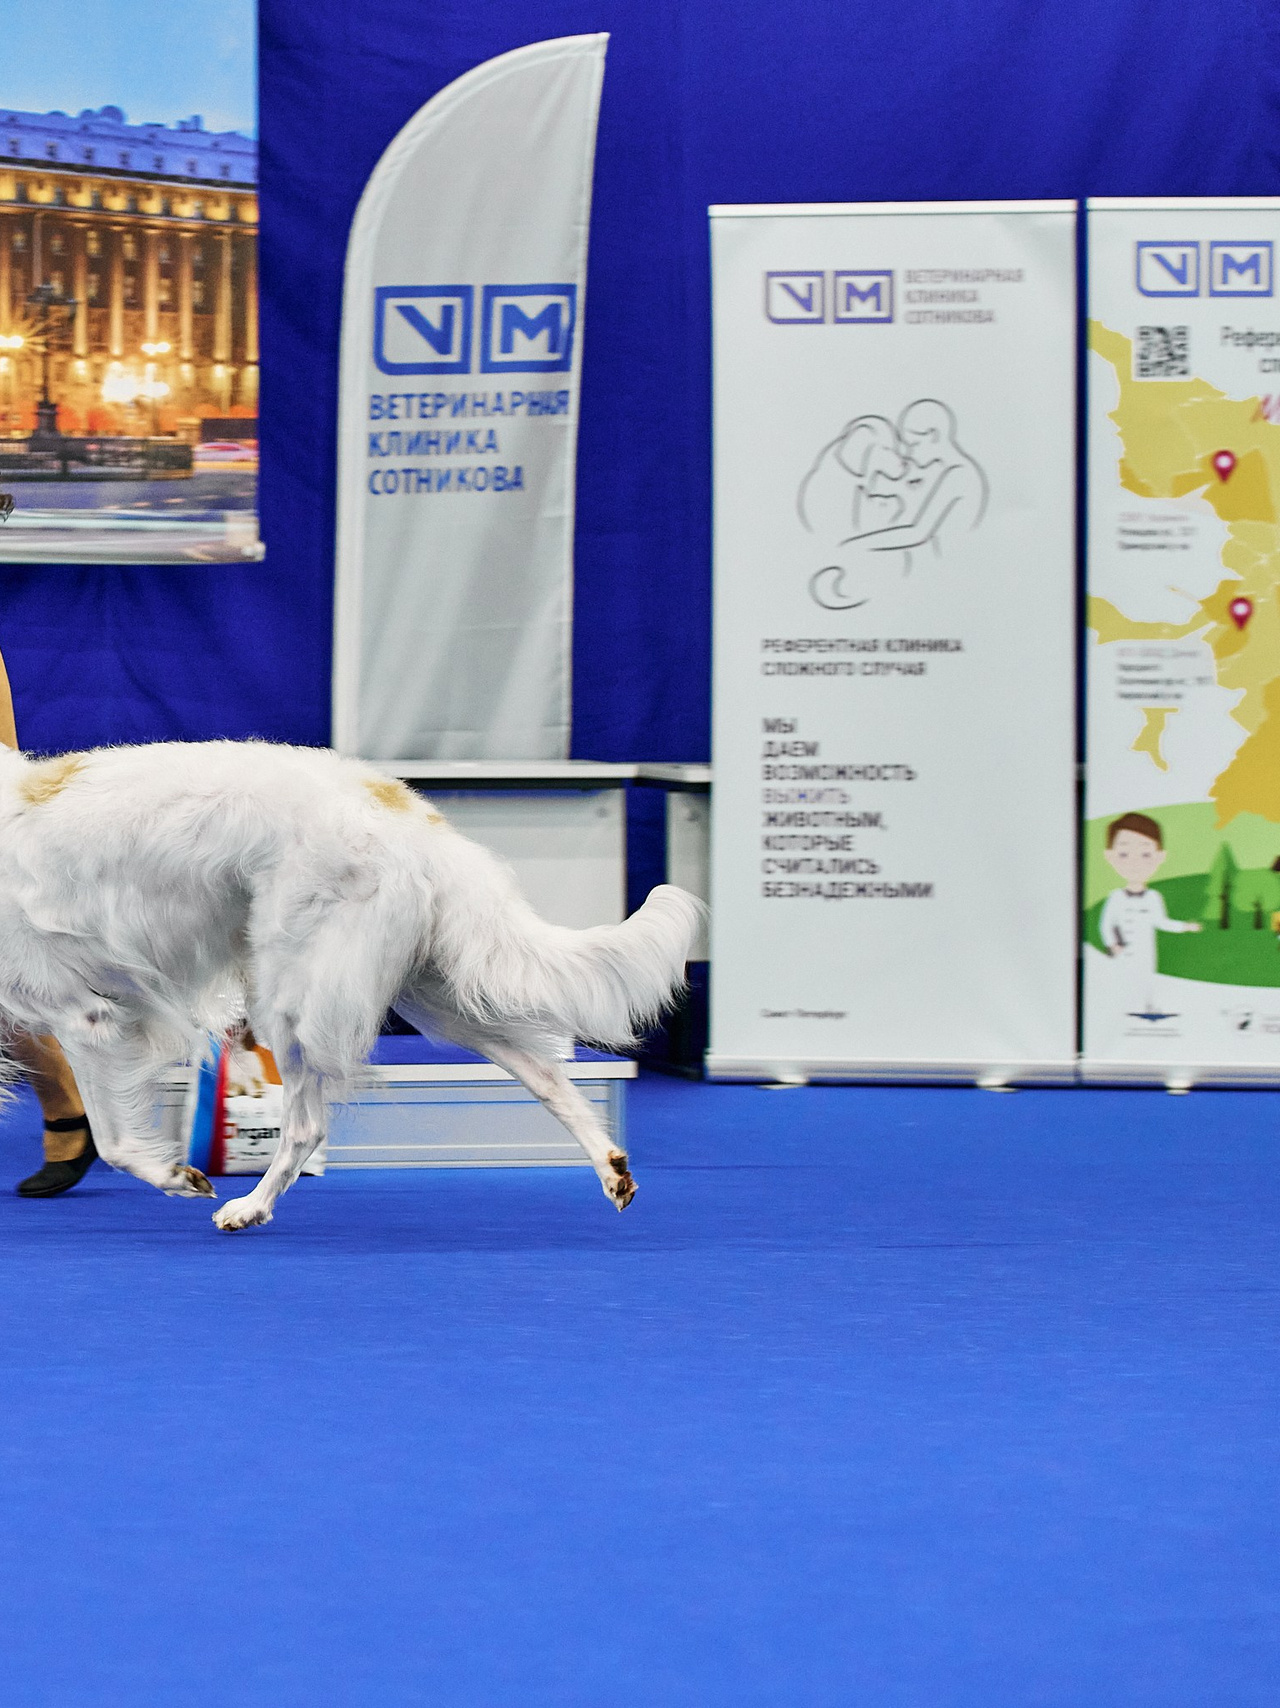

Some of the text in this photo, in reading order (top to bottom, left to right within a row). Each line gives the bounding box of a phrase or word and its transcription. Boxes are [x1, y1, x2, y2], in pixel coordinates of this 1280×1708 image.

[368, 430, 499, 458] КЛИНИКА
[368, 466, 524, 495] СОТНИКОВА
[884, 638, 964, 653] КЛИНИКА
[762, 661, 928, 676] СЛОЖНОГО СЛУЧАЯ
[762, 717, 797, 734] МЫ
[761, 740, 819, 760] ДАЕМ
[762, 764, 917, 782] ВОЗМОЖНОСТЬ
[762, 787, 851, 804] ВЫЖИТЬ
[762, 811, 887, 831] ЖИВОТНЫМ,
[762, 834, 854, 852] КОТОРЫЕ
[762, 857, 881, 875] СЧИТАЛИСЬ
[762, 881, 935, 901] БЕЗНАДЕЖНЫМИ
